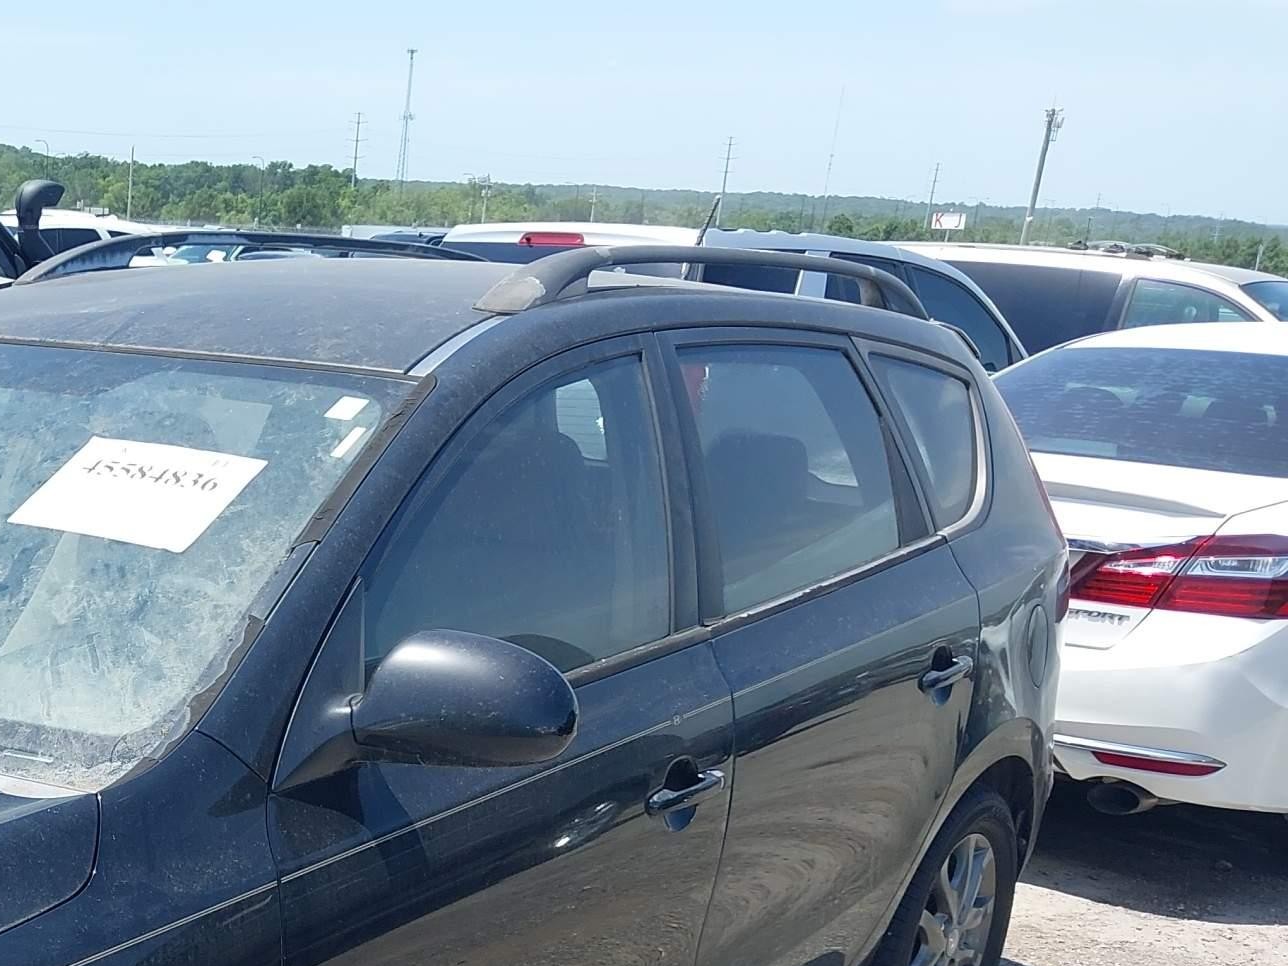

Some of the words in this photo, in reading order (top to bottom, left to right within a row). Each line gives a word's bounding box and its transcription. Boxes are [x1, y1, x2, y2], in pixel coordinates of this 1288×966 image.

[934, 212, 944, 228] K
[954, 212, 963, 228] J
[82, 459, 219, 491] 45584836
